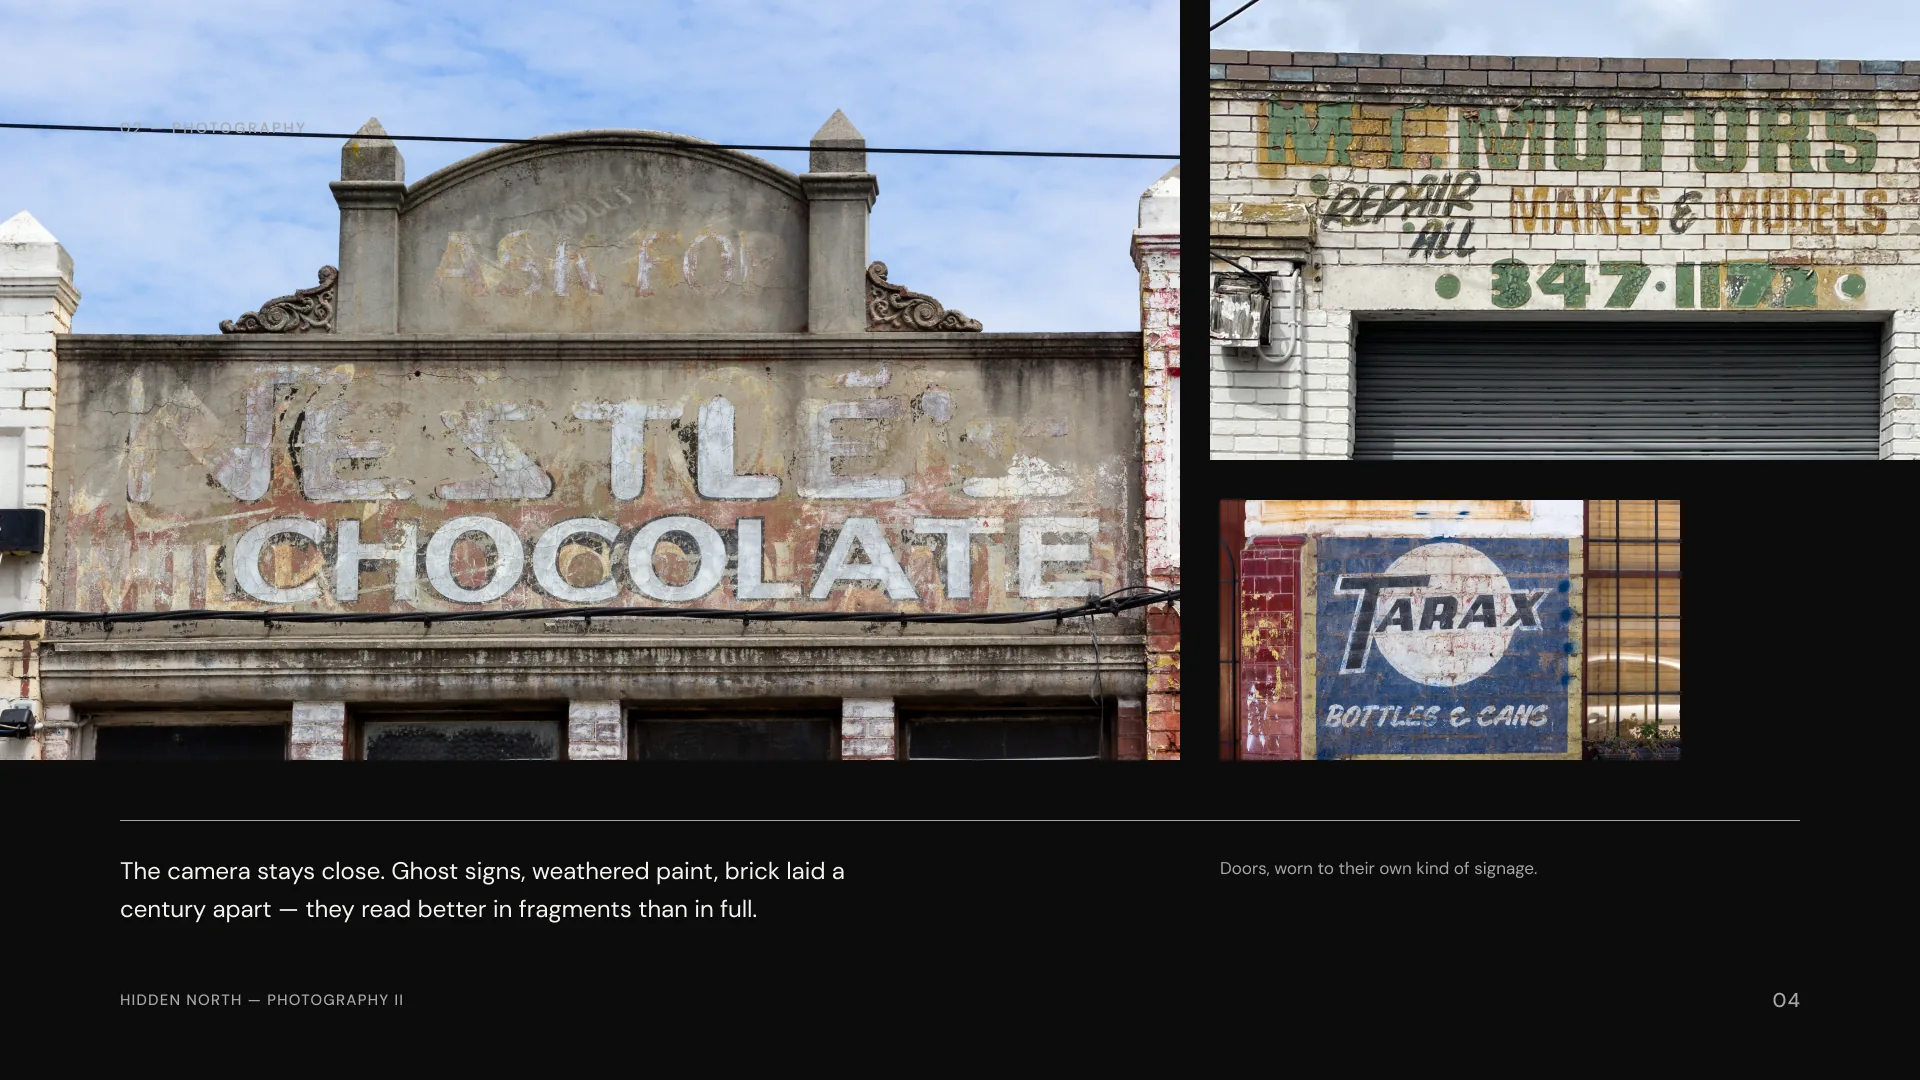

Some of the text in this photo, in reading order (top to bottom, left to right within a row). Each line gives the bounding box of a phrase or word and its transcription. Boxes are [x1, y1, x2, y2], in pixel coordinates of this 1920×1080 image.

[1320, 170, 1482, 230] REPAIR
[1511, 186, 1660, 234] MAKES
[1715, 187, 1888, 234] MODELS
[1409, 217, 1476, 259] ALL
[231, 515, 1102, 604] CHOCOLATE
[1325, 703, 1441, 728] BOTTLES
[1476, 704, 1549, 727] CANS
